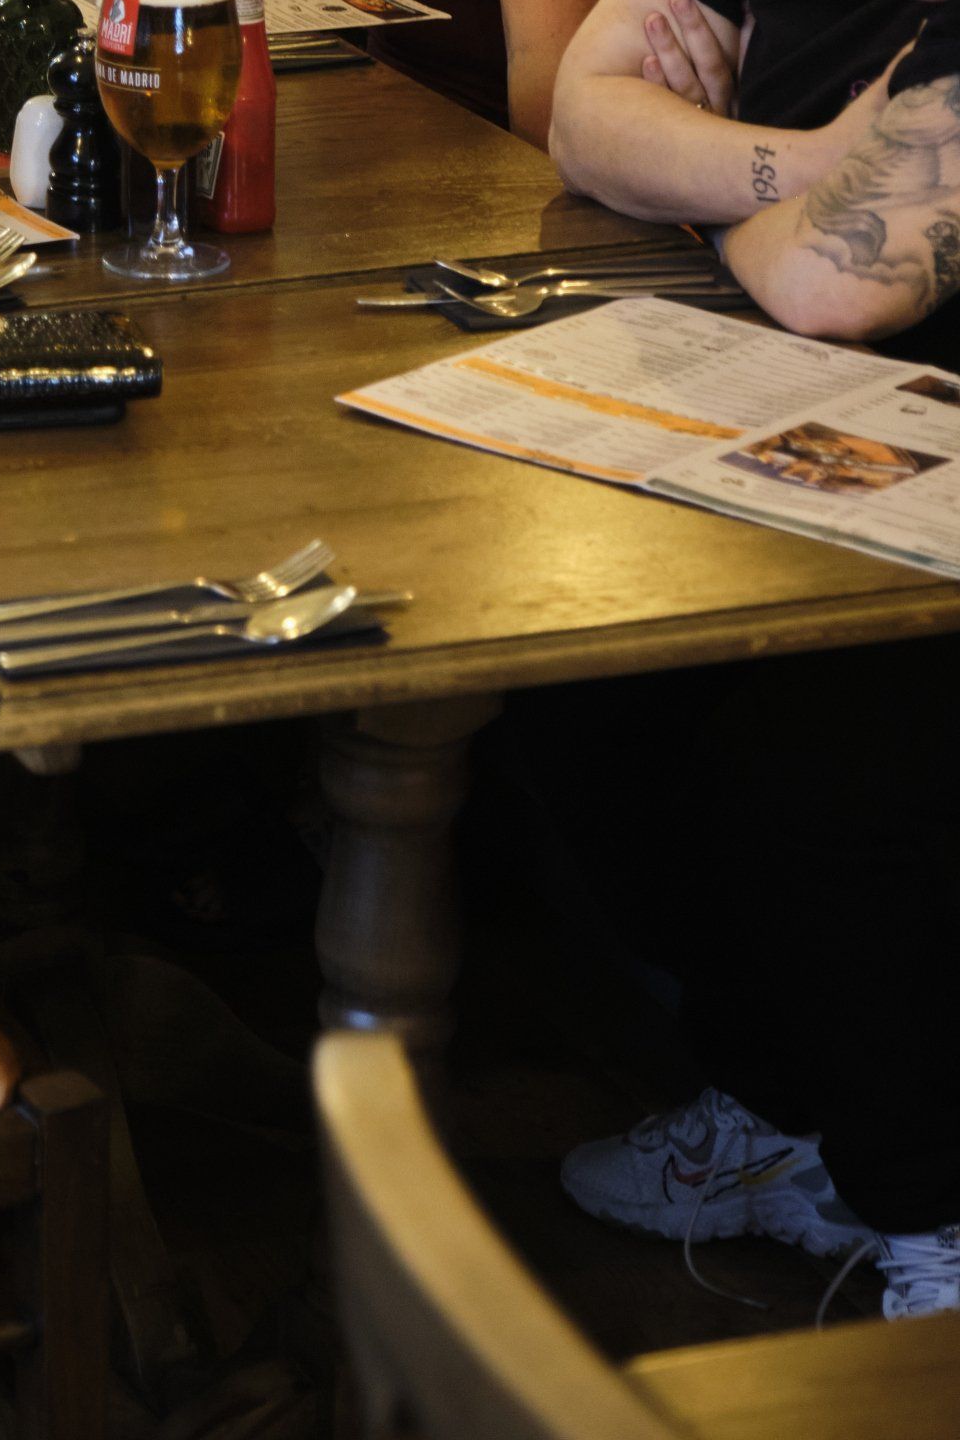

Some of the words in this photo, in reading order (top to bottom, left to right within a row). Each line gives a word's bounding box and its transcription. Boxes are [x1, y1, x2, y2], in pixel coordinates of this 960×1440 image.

[107, 66, 117, 83] DE
[120, 69, 161, 89] MADRID
[752, 143, 781, 203] 1954
